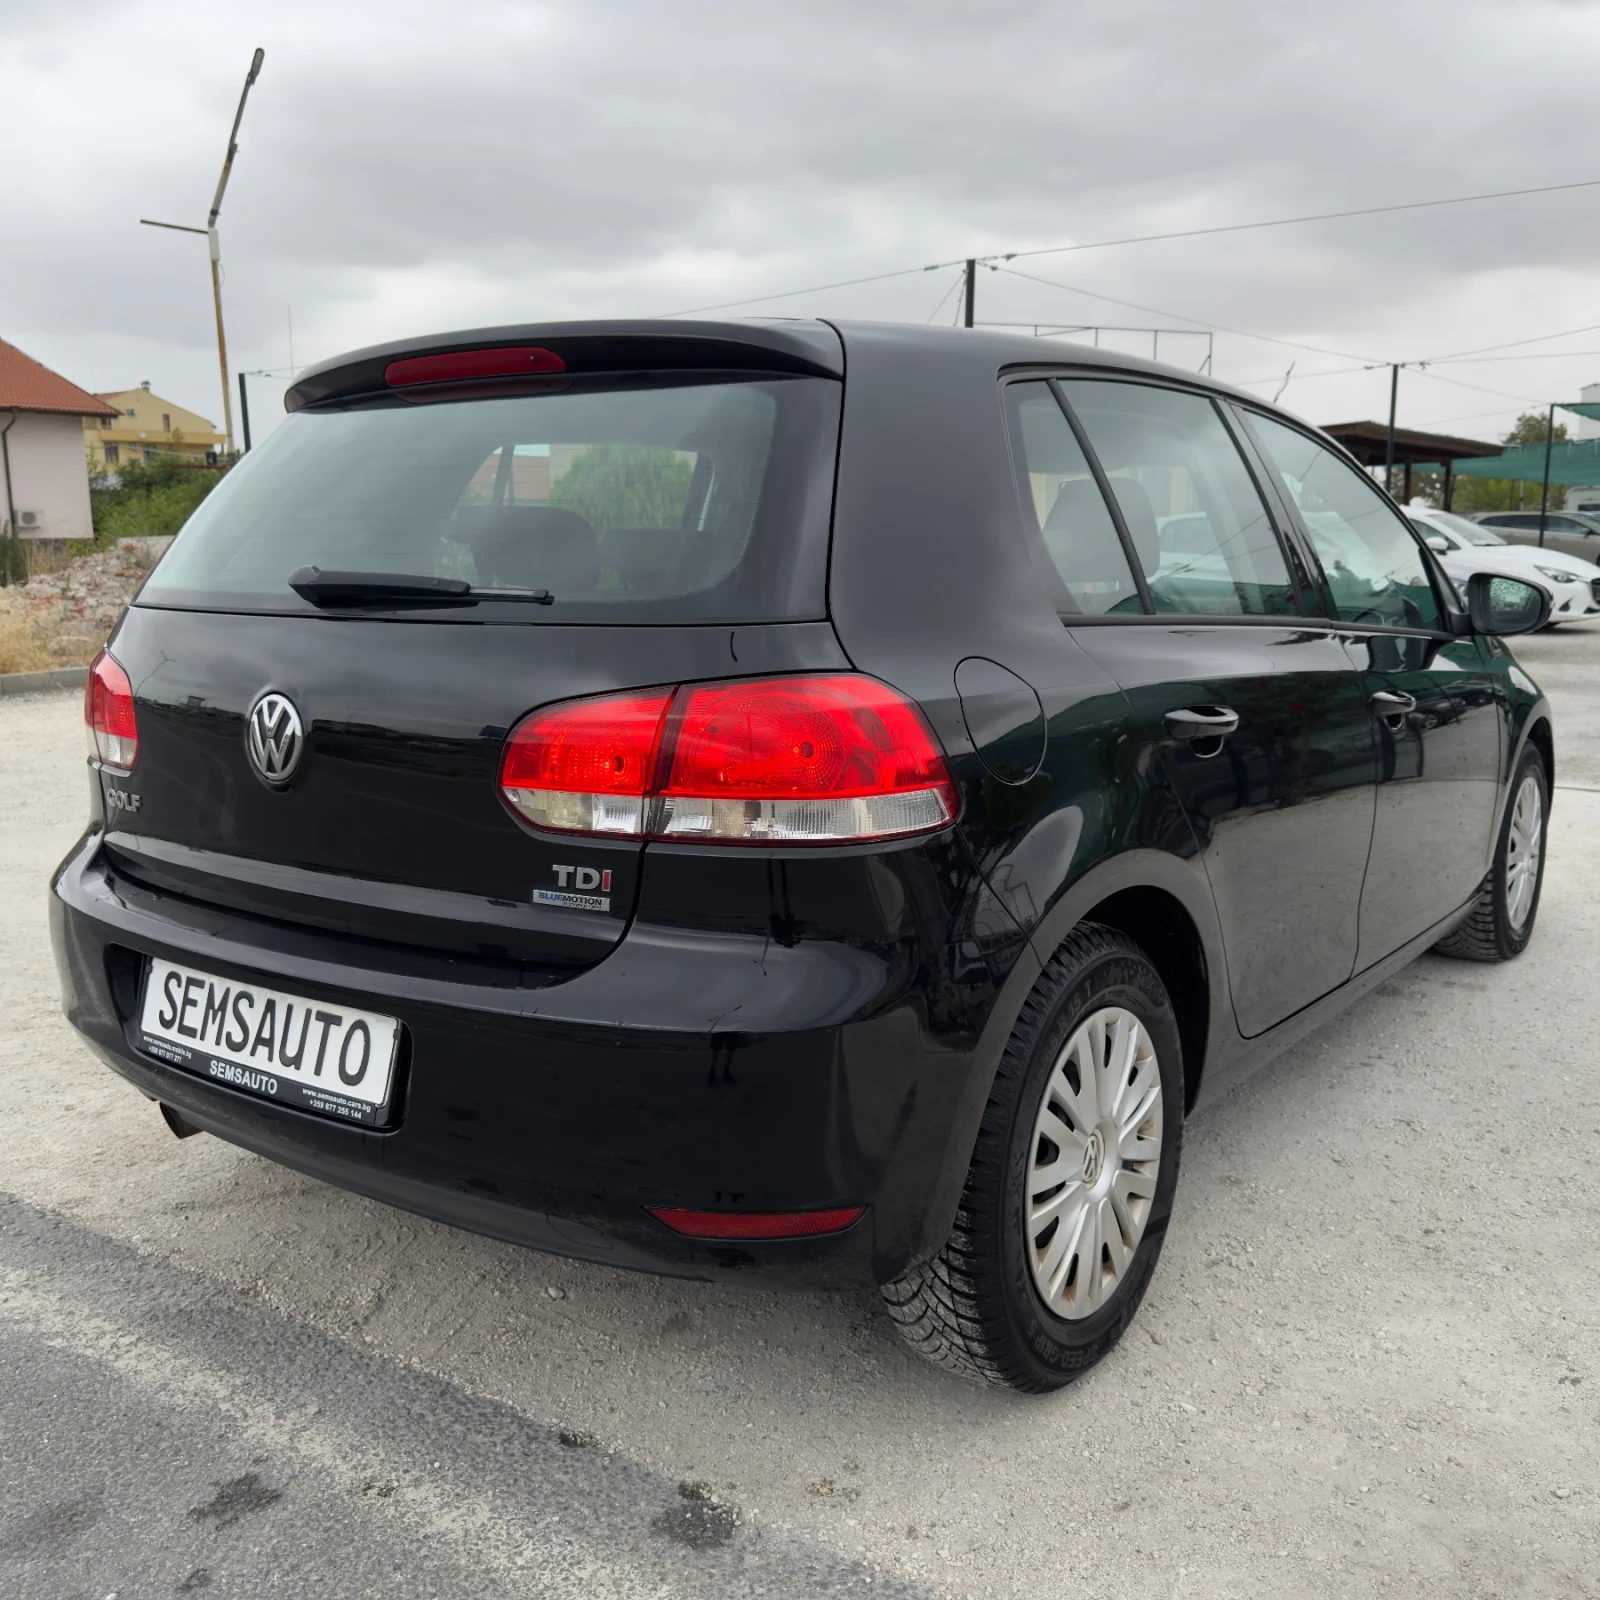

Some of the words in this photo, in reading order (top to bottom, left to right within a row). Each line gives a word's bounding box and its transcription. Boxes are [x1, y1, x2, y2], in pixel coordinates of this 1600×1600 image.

[106, 788, 141, 812] GOLF
[552, 864, 612, 892] TDI
[538, 891, 603, 906] BLUEMOTION
[158, 970, 371, 1087] SEMSAUTO
[209, 1060, 278, 1094] SEMSAUTO
[302, 1088, 371, 1113] www.semsauto.cars.bg
[309, 1099, 324, 1109] +359
[325, 1103, 336, 1112] 877
[337, 1106, 349, 1116] 255
[350, 1110, 362, 1119] 144
[1027, 1318, 1038, 1338] 5
[1034, 1334, 1099, 1368] SPEED-GRIP
